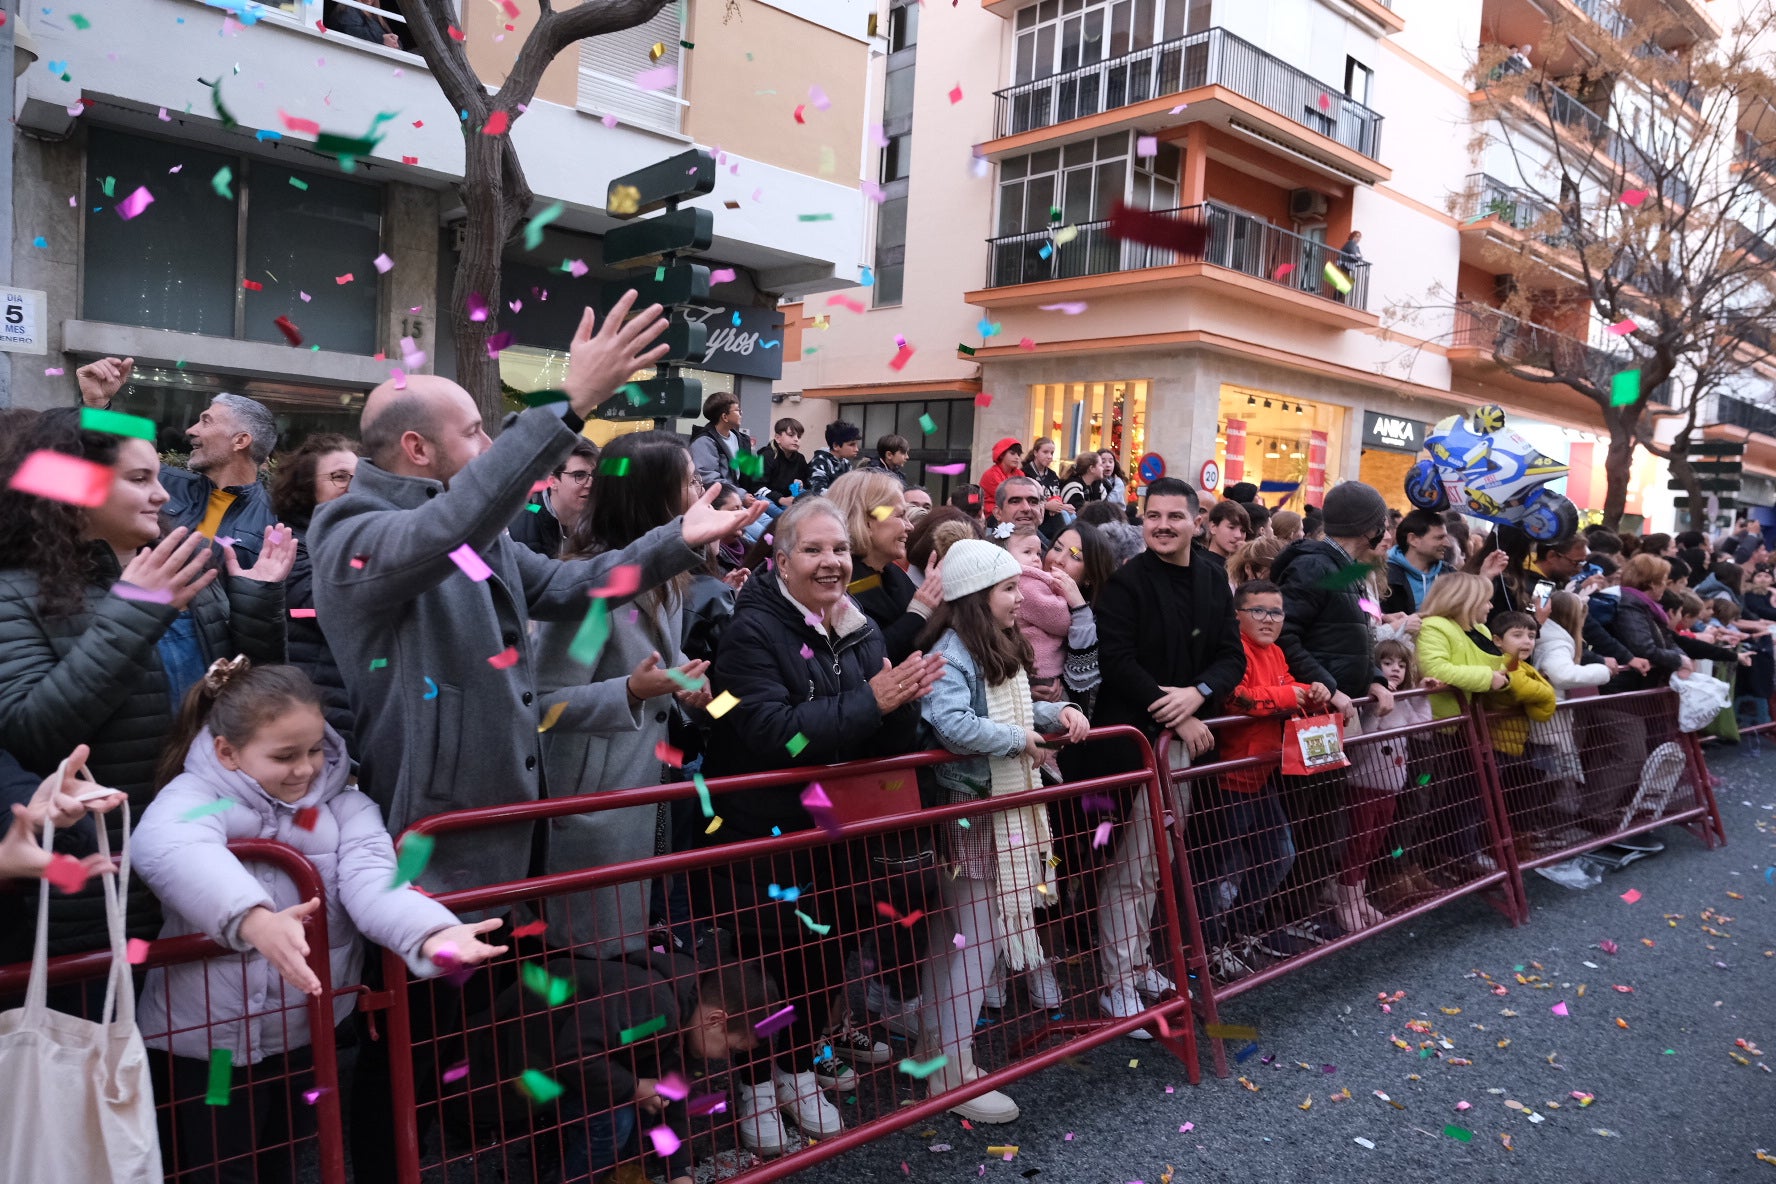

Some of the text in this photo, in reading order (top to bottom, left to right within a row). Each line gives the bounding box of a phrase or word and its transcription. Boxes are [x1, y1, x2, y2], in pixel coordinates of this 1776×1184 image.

[7, 293, 23, 303] DIA
[5, 304, 24, 324] 5
[5, 324, 25, 334] MES
[402, 318, 424, 339] 15
[0, 335, 33, 345] ENERO
[1373, 417, 1414, 441] ANKA
[1205, 471, 1217, 482] 20
